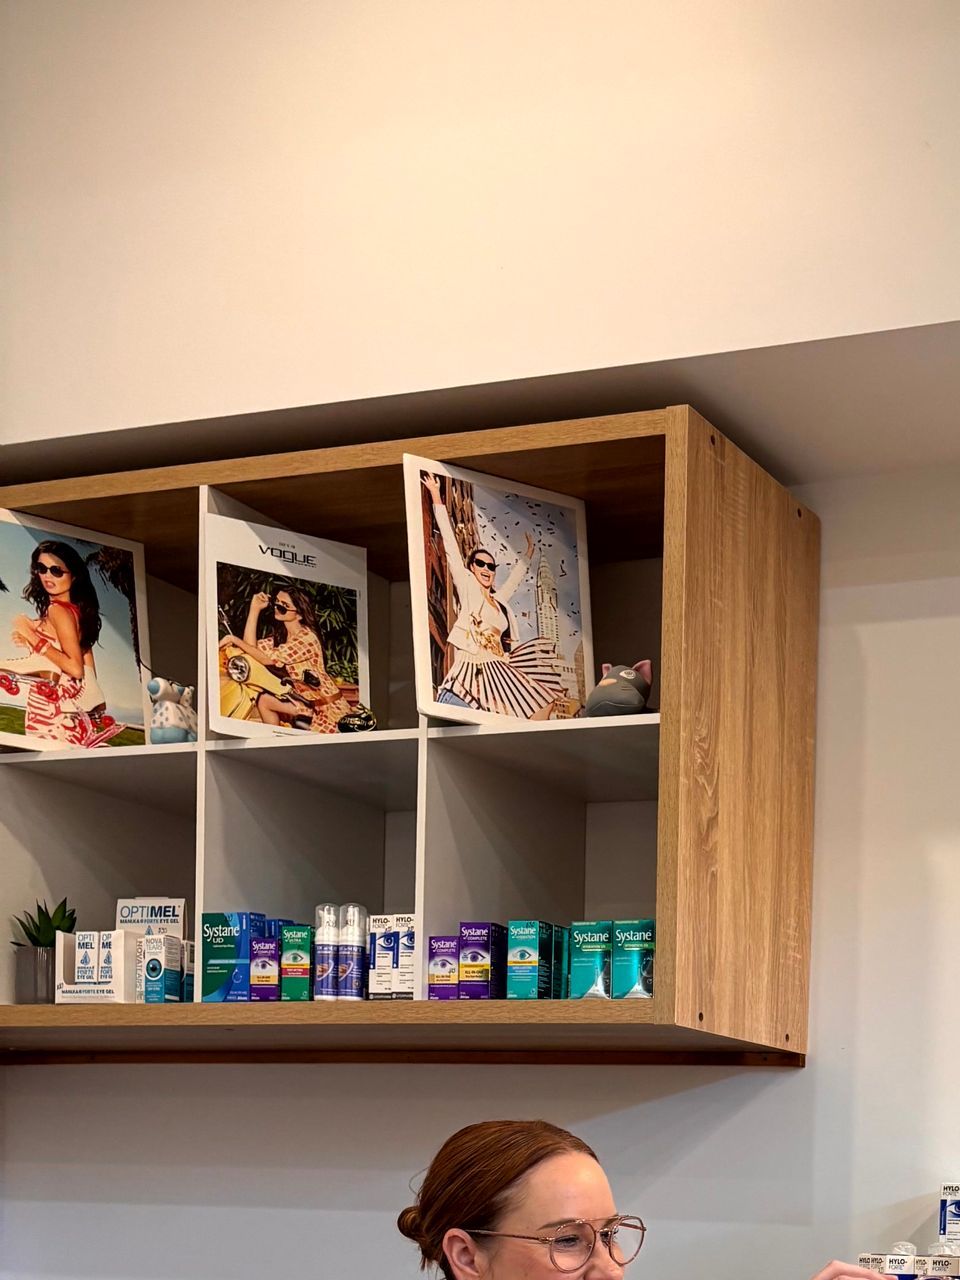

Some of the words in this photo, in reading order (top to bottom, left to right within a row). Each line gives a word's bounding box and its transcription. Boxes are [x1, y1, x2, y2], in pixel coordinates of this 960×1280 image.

[258, 544, 317, 564] VOGUE
[120, 905, 179, 919] OPTIMEL
[77, 933, 95, 941] OPTI
[203, 923, 241, 942] Systane
[283, 929, 308, 942] Systane
[461, 926, 488, 940] Systane
[510, 926, 537, 939] Systane
[573, 930, 609, 947] Systane
[615, 929, 652, 946] Systane
[77, 941, 95, 949] MEL
[145, 938, 162, 946] NOVA
[252, 941, 276, 954] Systane
[431, 939, 457, 952] Systane
[932, 1259, 952, 1267] HYLO-
